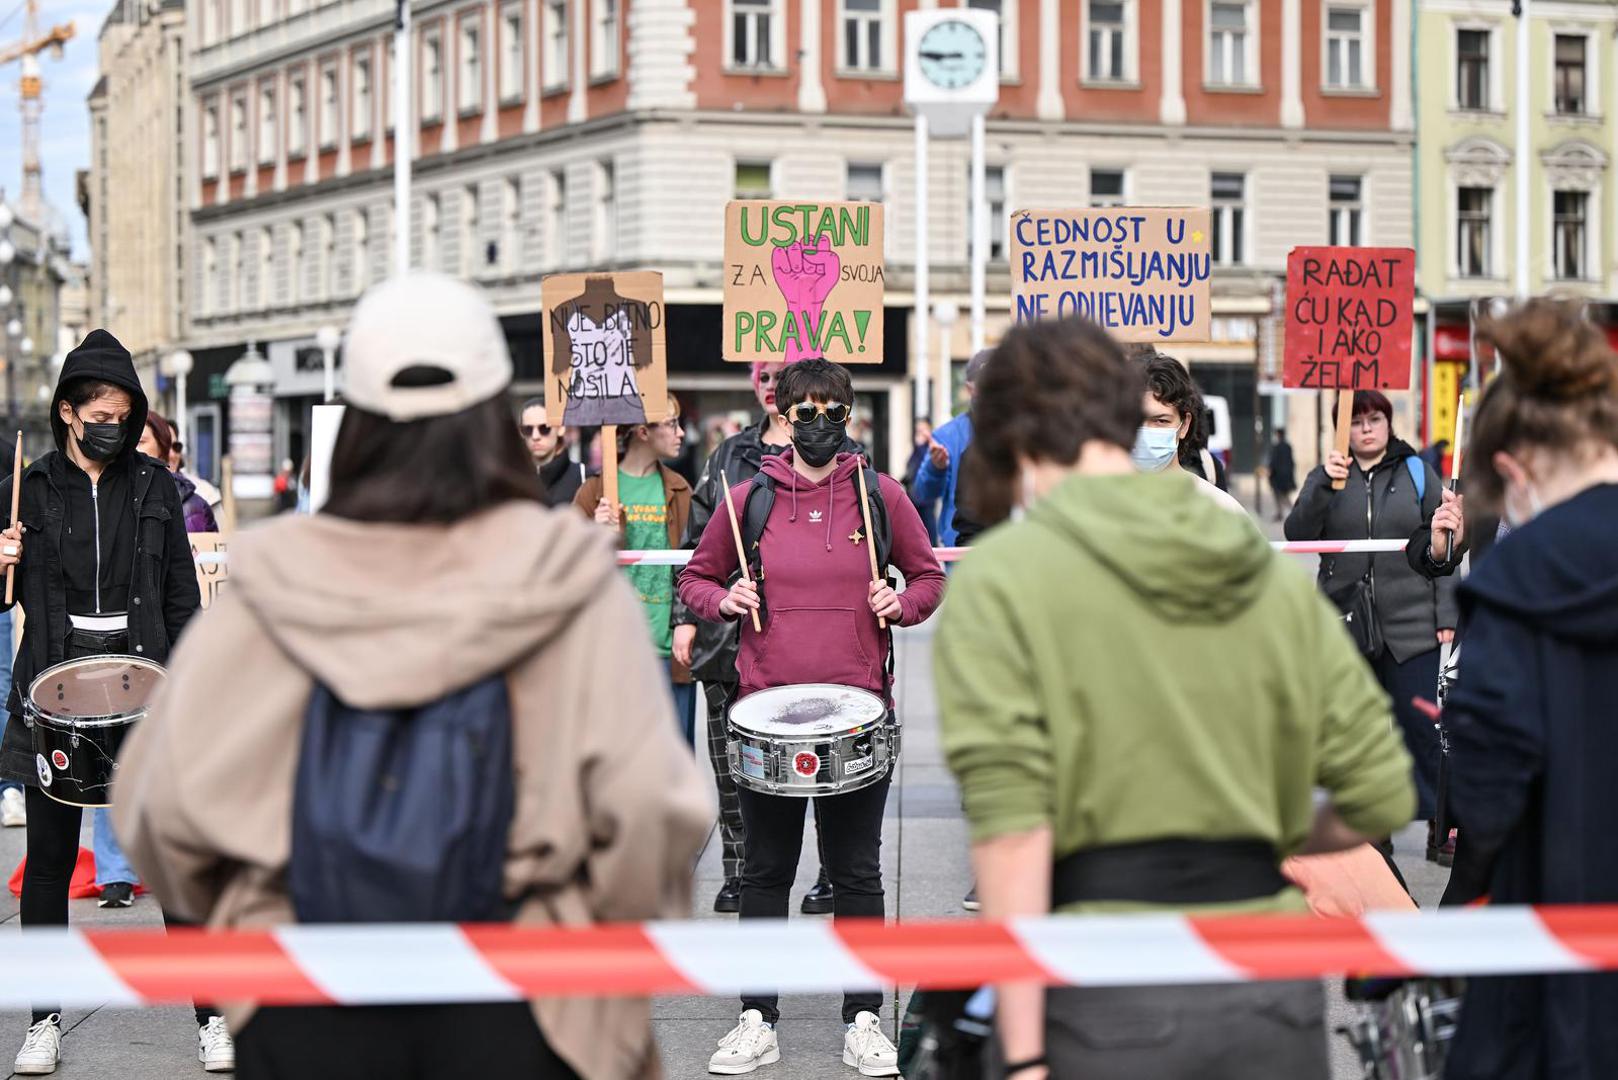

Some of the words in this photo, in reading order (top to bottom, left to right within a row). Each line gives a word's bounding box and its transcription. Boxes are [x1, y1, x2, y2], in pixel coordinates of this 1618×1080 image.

[740, 205, 870, 247] USTANI
[1016, 212, 1146, 247] ČEDNOST
[1166, 217, 1186, 245] U
[731, 264, 767, 286] ZA
[841, 264, 885, 283] SVOJA
[1022, 244, 1211, 288] RAZMIŠLJANJU
[1303, 258, 1401, 288] RAĐAT
[549, 304, 592, 334] NIJE
[603, 301, 661, 331] BITNO
[1016, 293, 1049, 326] NE
[1295, 290, 1329, 325] ĆU
[1338, 296, 1397, 328] KAD
[735, 310, 872, 354] PRAVA!
[569, 338, 608, 368] ŠTO
[615, 338, 640, 367] JE
[558, 371, 645, 403] NOSILA.
[1300, 355, 1389, 389] ŽELIM.
